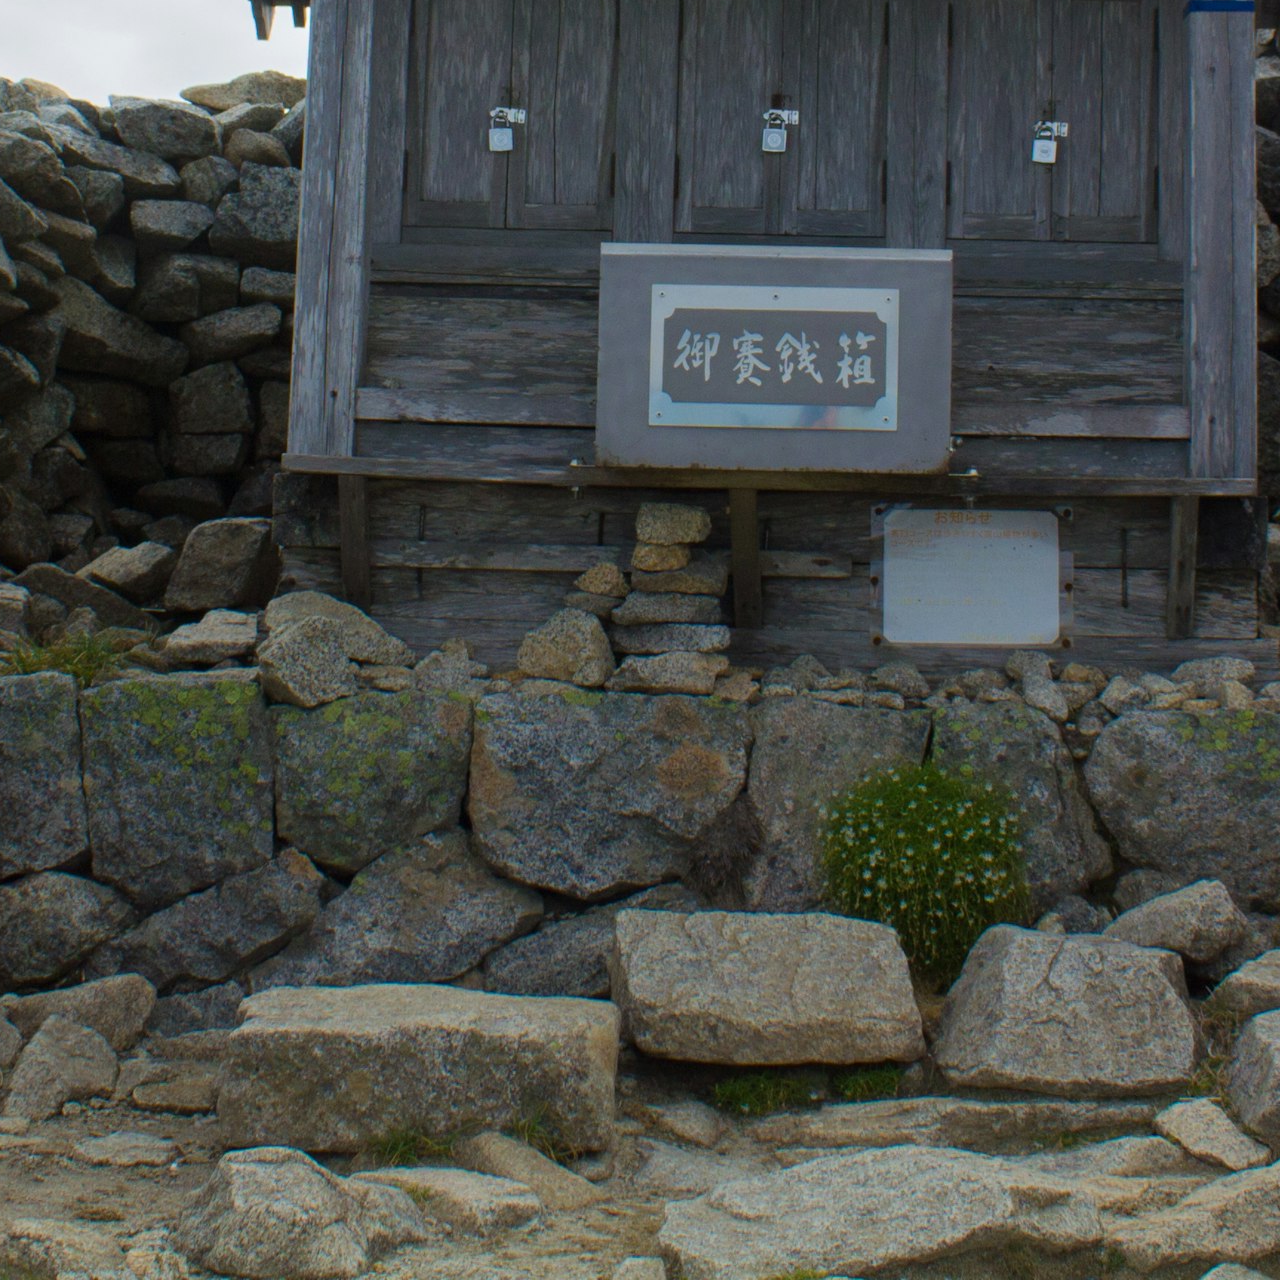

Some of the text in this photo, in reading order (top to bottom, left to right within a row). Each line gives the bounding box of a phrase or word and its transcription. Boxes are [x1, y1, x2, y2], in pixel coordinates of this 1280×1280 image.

[673, 328, 876, 389] 御賽銭箱
[933, 511, 993, 525] お知らせ
